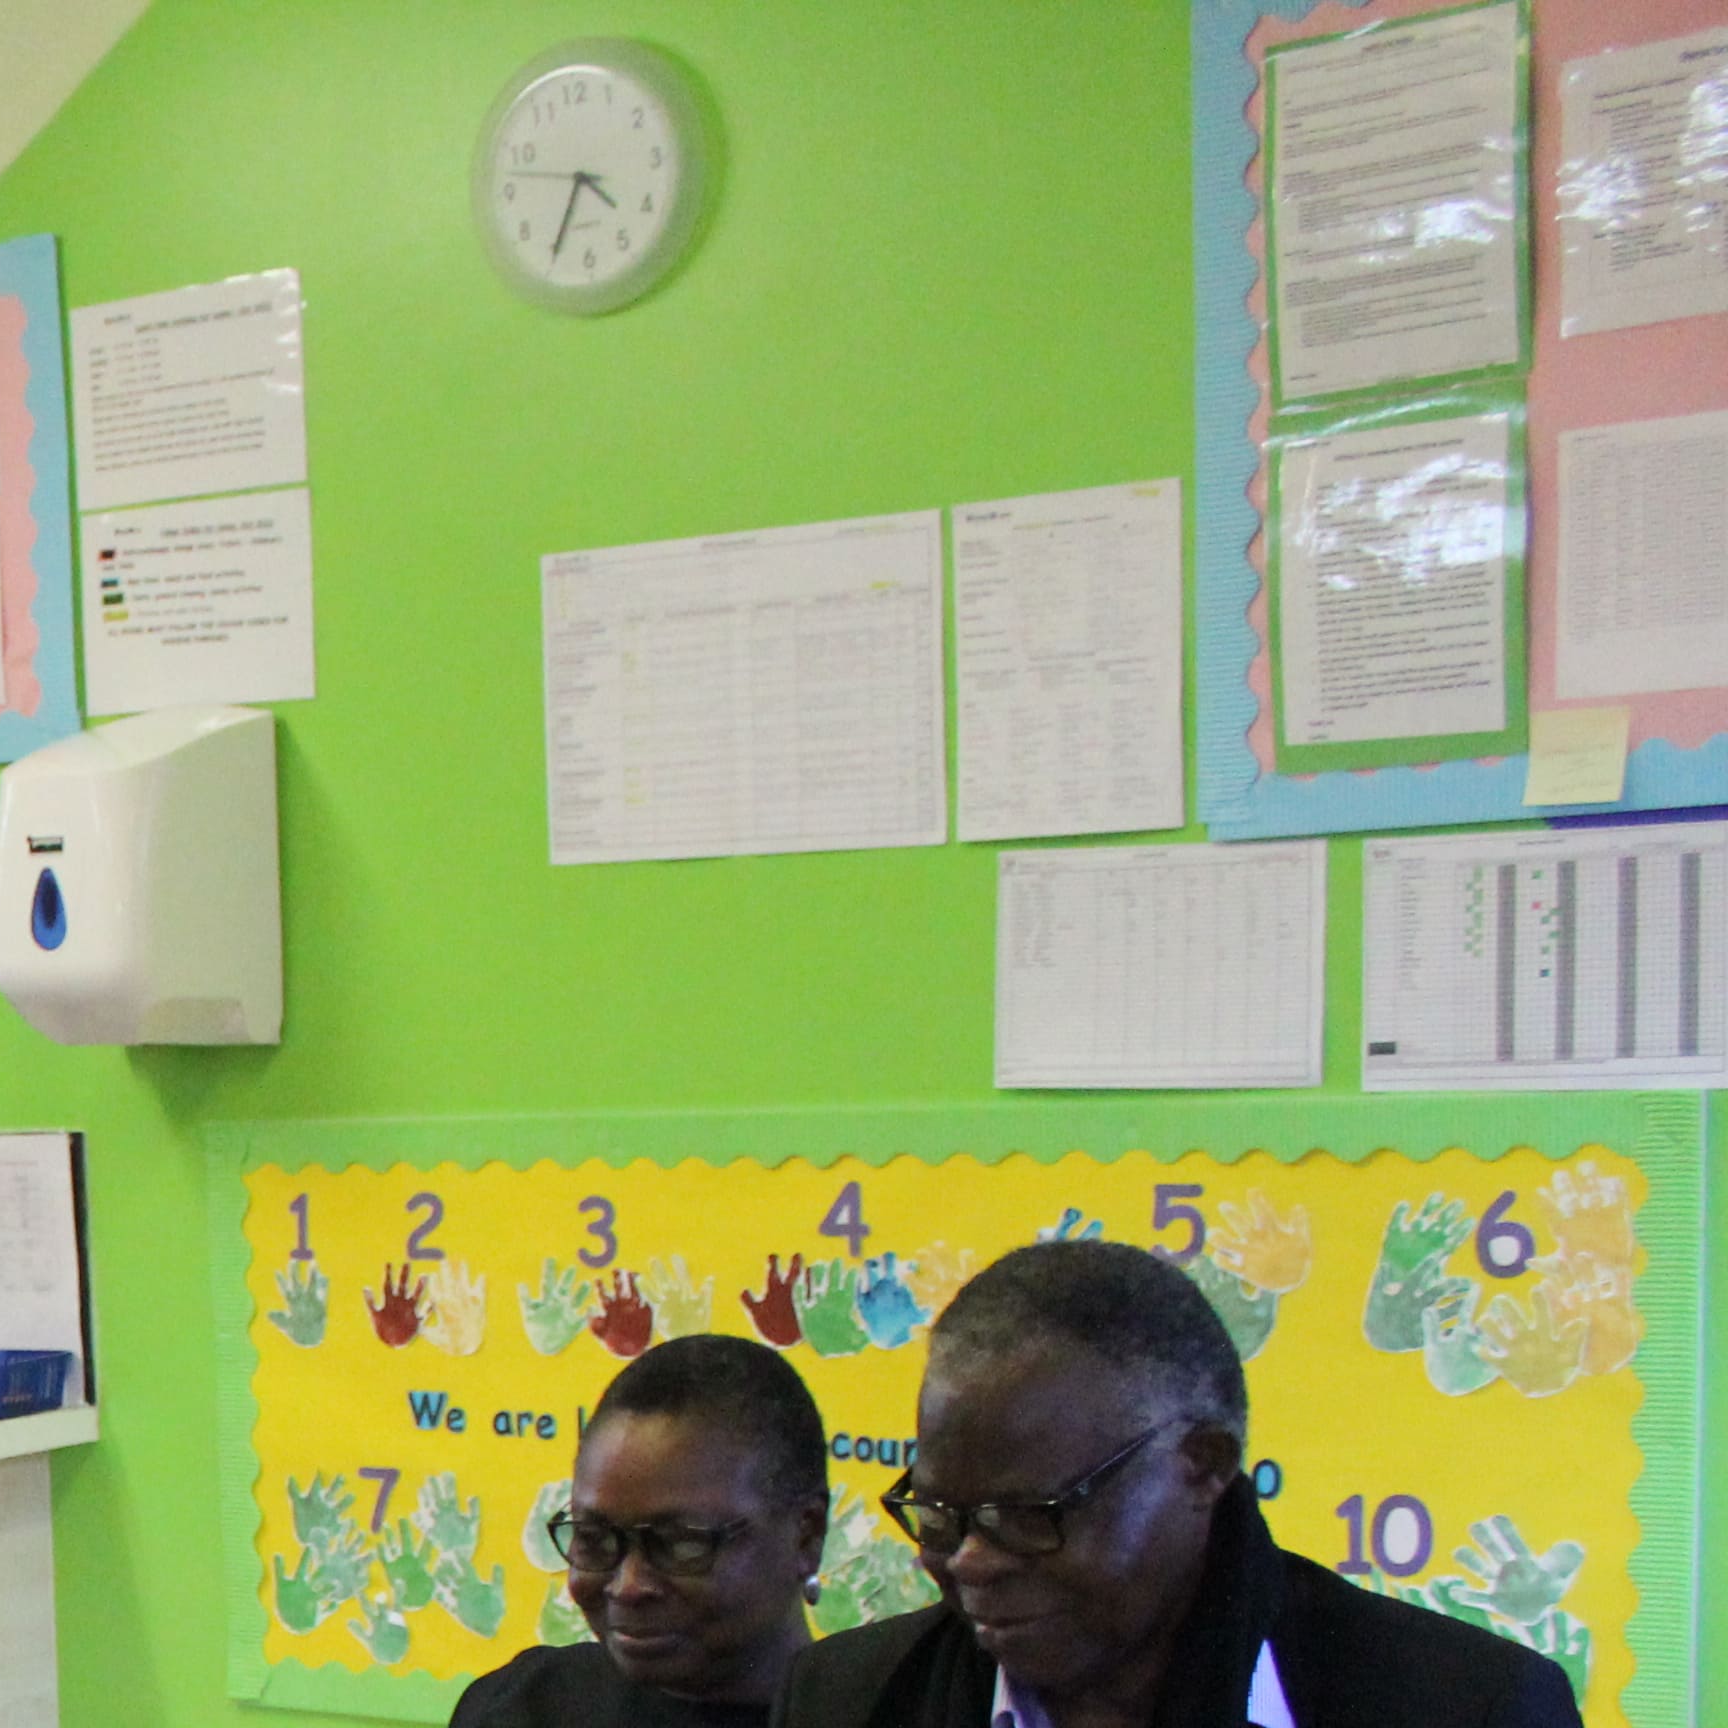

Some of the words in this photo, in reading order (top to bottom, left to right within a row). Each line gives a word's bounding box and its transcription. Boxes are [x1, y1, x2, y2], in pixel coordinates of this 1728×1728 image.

[562, 80, 587, 105] 12
[604, 83, 613, 105] 1
[532, 101, 554, 128] 11
[631, 107, 644, 129] 2
[511, 143, 536, 165] 10
[650, 146, 662, 169] 3
[504, 182, 516, 204] 9
[640, 192, 653, 213] 4
[519, 220, 531, 241] 8
[616, 228, 630, 250] 5
[582, 250, 595, 269] 6
[289, 1193, 313, 1260] 1
[406, 1192, 444, 1260] 2
[578, 1195, 617, 1268] 3
[818, 1181, 870, 1257] 4
[1151, 1183, 1206, 1264] 5
[1476, 1190, 1534, 1279] 6
[408, 1389, 466, 1433] We
[493, 1410, 557, 1440] are
[358, 1467, 401, 1534] 7
[1335, 1494, 1433, 1578] 10
